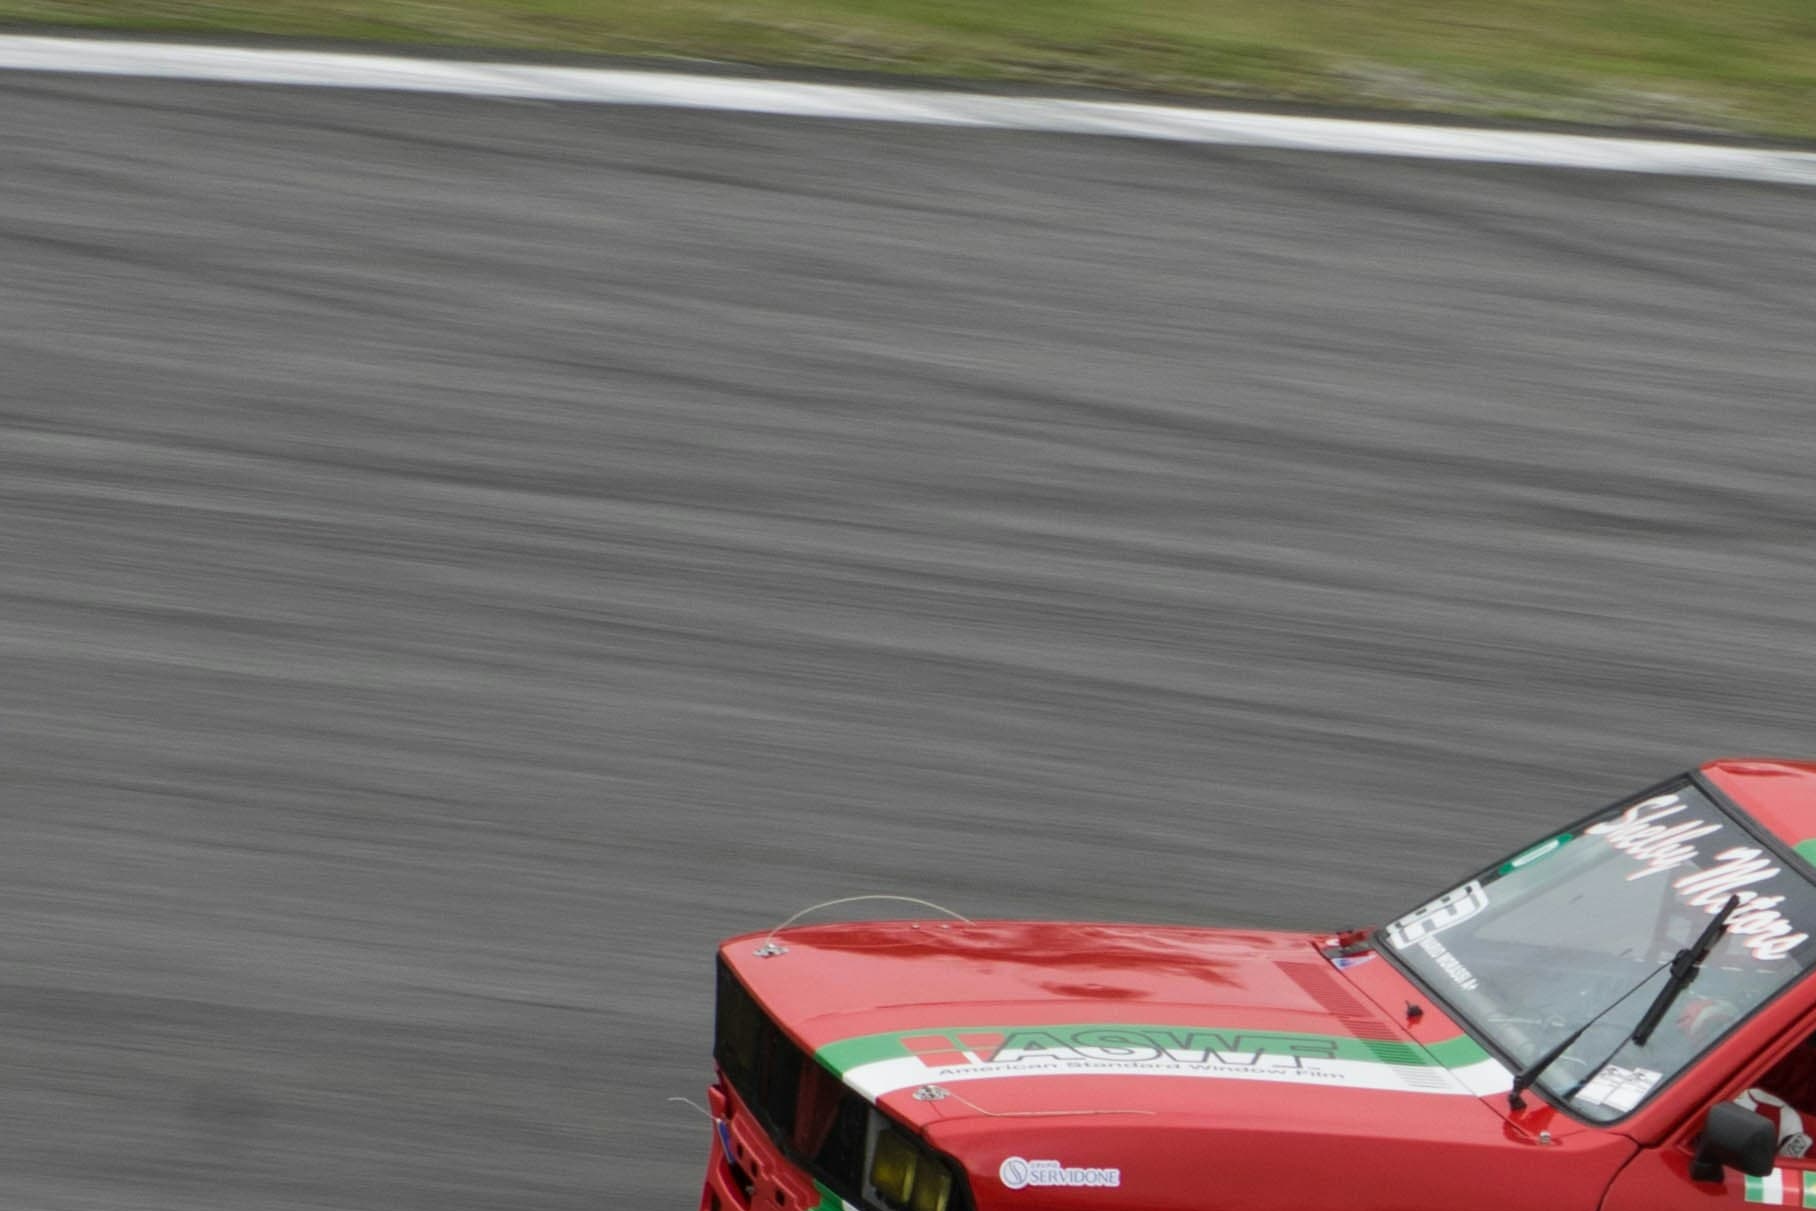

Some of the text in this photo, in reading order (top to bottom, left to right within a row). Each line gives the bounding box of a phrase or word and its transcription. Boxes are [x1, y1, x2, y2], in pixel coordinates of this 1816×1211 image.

[1585, 794, 1809, 960] Shelby Motors
[989, 1031, 1339, 1070] ASWF
[938, 1060, 1345, 1080] American Standard Window Film
[1031, 1169, 1117, 1185] SERVIDONE
